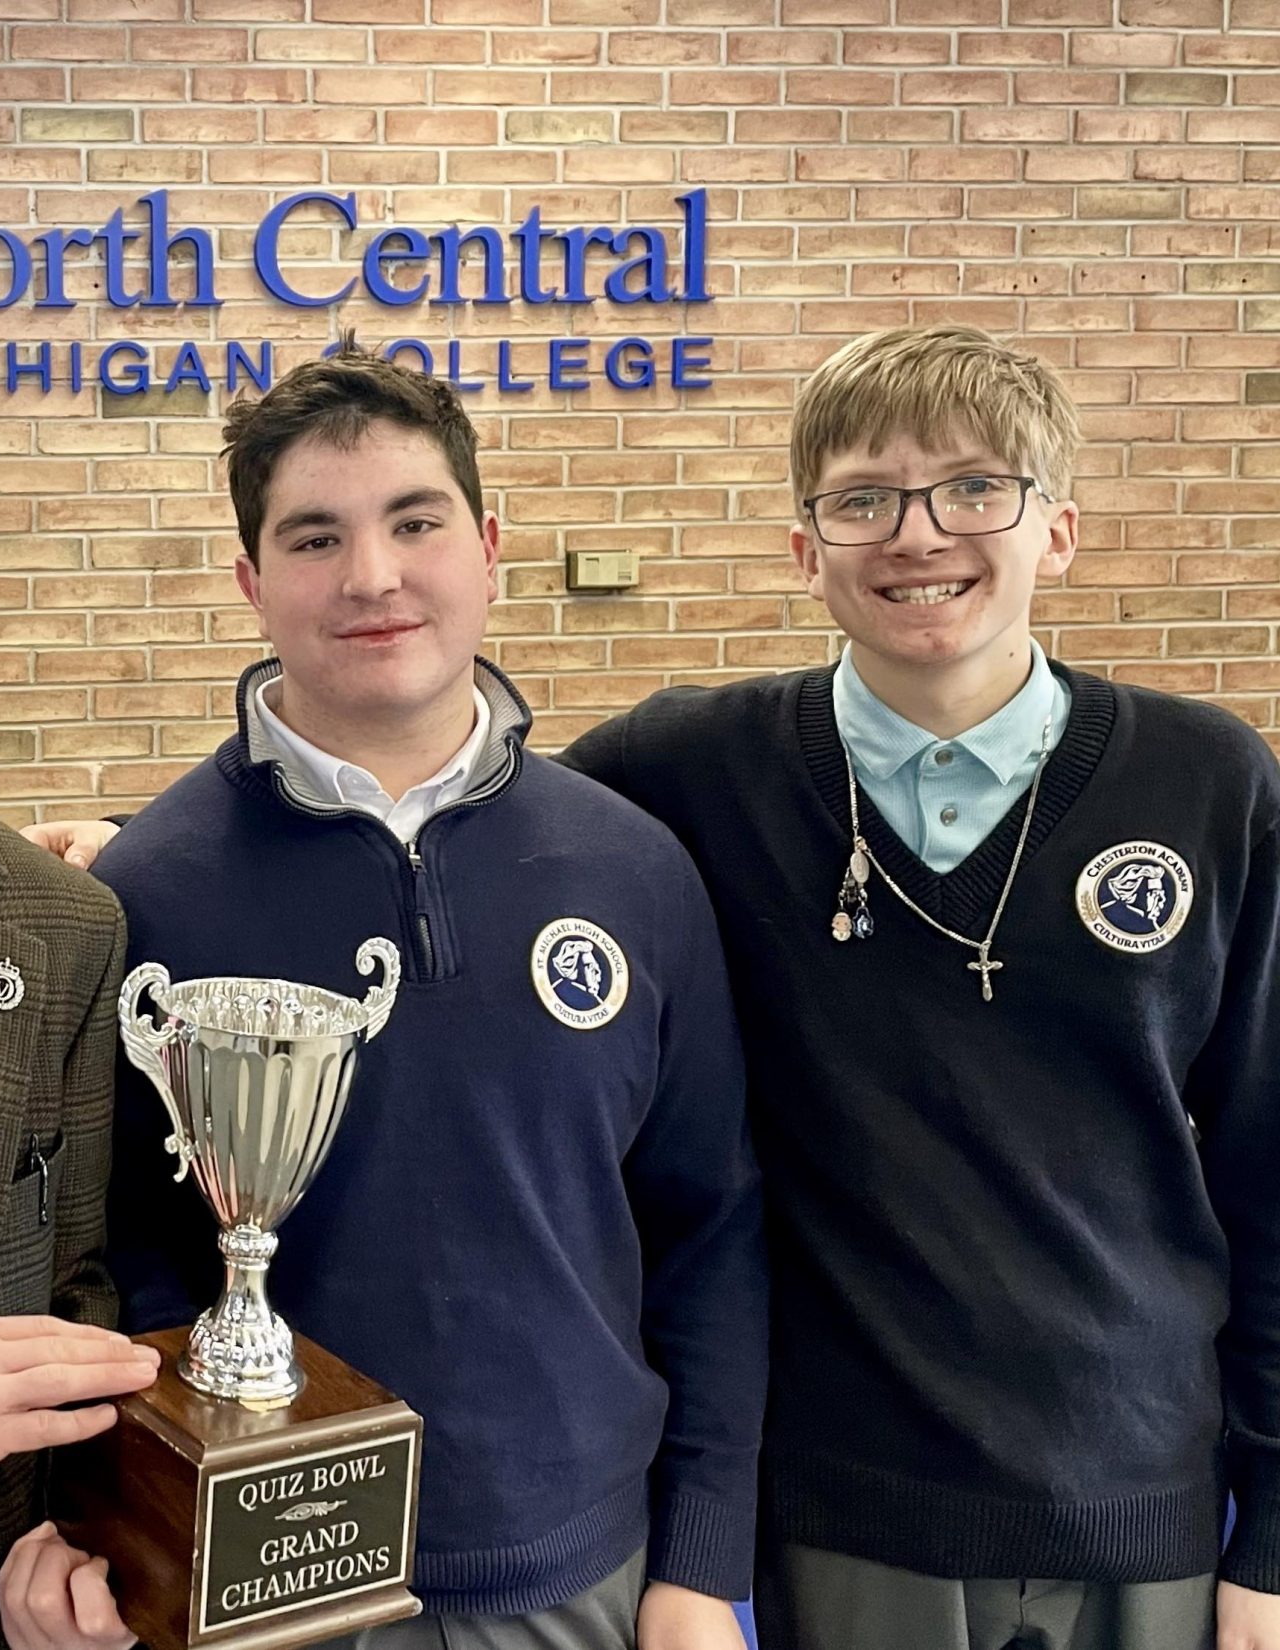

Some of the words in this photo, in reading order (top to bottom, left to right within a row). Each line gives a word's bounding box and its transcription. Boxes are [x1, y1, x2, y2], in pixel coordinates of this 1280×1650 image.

[253, 187, 716, 307] Central
[1087, 846, 1157, 878] CHESTERTON
[1157, 851, 1188, 893] ACADEMY
[1093, 922, 1139, 949] CULTURA
[554, 1003, 587, 1024] CULTURA
[238, 1472, 304, 1512] QUIZ
[311, 1454, 386, 1492] BOWL
[260, 1520, 360, 1566] GRAND
[221, 1546, 391, 1611] CHAMPIONS
